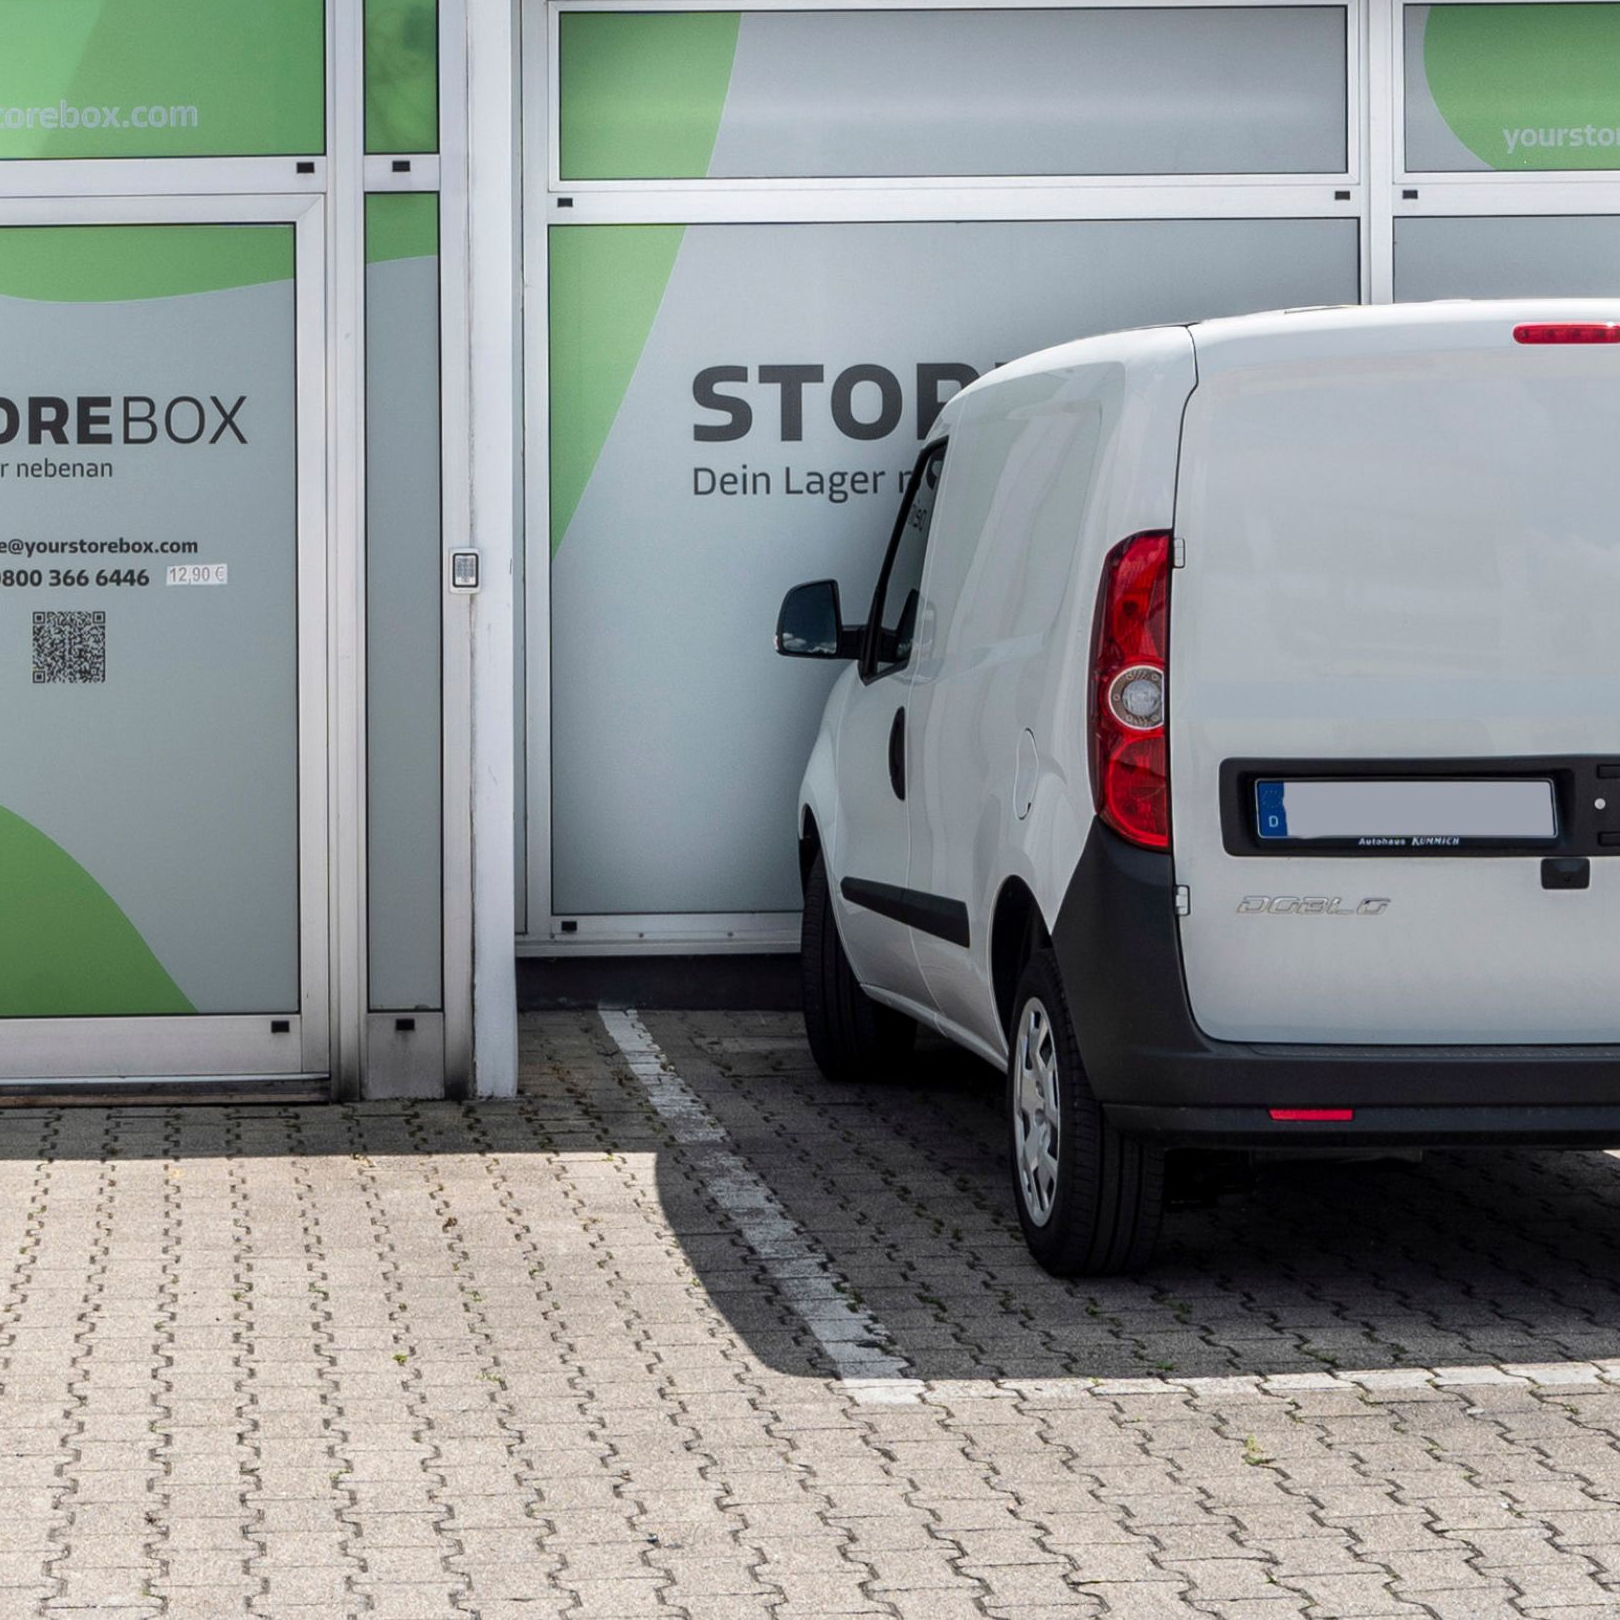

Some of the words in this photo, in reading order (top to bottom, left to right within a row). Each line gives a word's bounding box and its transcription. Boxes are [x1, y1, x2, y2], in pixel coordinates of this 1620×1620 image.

[16, 458, 113, 478] nebenan
[693, 464, 772, 496] Dein
[784, 466, 886, 504] Lager
[48, 569, 90, 587] 366
[95, 569, 150, 587] 6446
[1268, 816, 1279, 828] D
[1359, 837, 1406, 846] Autohaus
